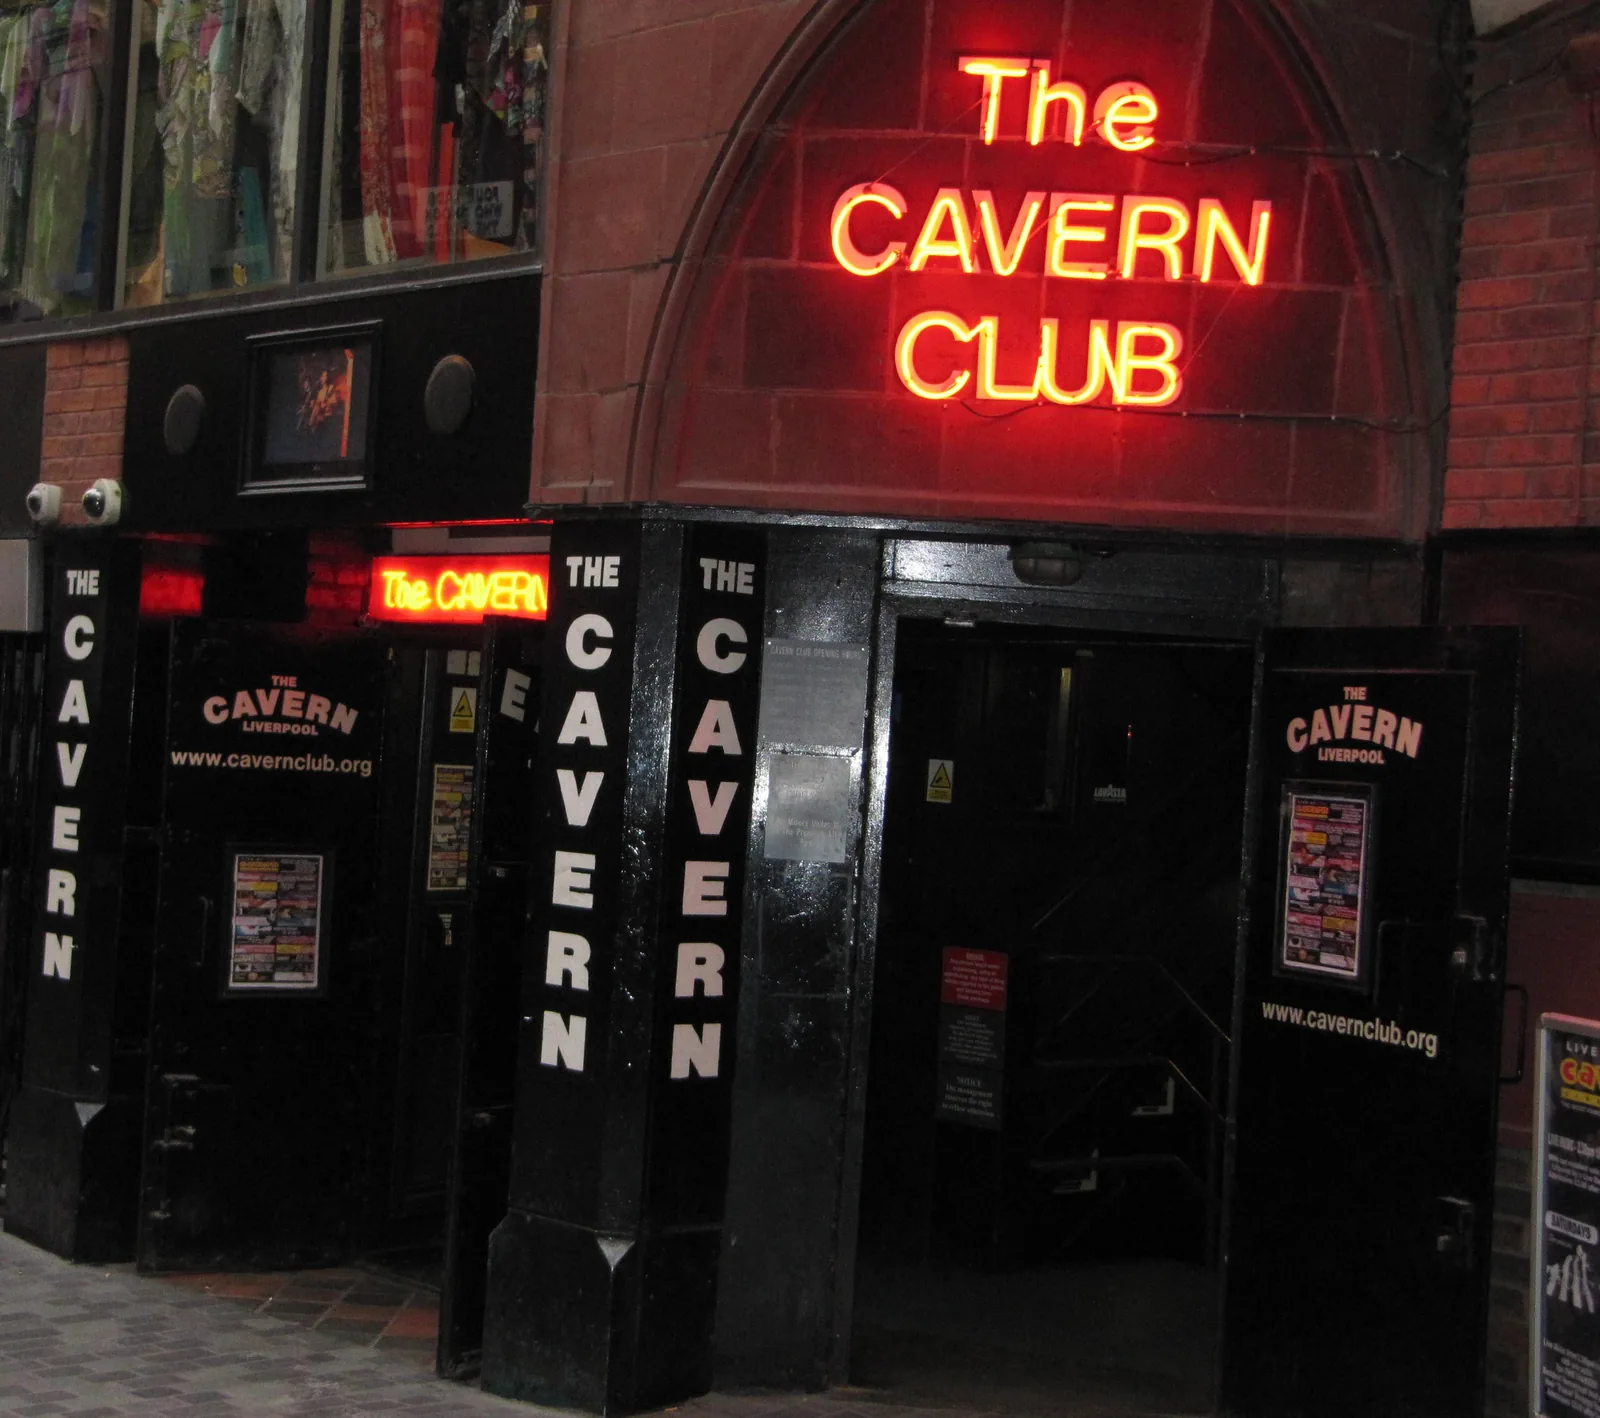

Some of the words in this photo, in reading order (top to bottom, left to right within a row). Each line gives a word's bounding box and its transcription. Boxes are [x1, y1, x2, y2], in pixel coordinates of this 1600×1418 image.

[958, 56, 1158, 151] The
[830, 182, 1272, 286] CAVERN
[895, 310, 1184, 407] CLUB
[67, 570, 99, 595] THE
[382, 570, 432, 610] The
[566, 556, 620, 587] THE
[700, 558, 755, 594] THE
[271, 675, 297, 687] THE
[1343, 686, 1368, 700] THE
[203, 688, 359, 735] CAVERN
[242, 720, 319, 736] LIVERPOOL
[1286, 704, 1423, 759] CAVERN
[171, 751, 373, 778] www.cavernclub.org
[1318, 747, 1386, 765] LIVERPOOL
[42, 615, 96, 981] CAVERN
[541, 613, 614, 1073] CAVERN
[670, 617, 748, 1079] CAVERN
[1262, 1001, 1438, 1058] www.cavernclub.org
